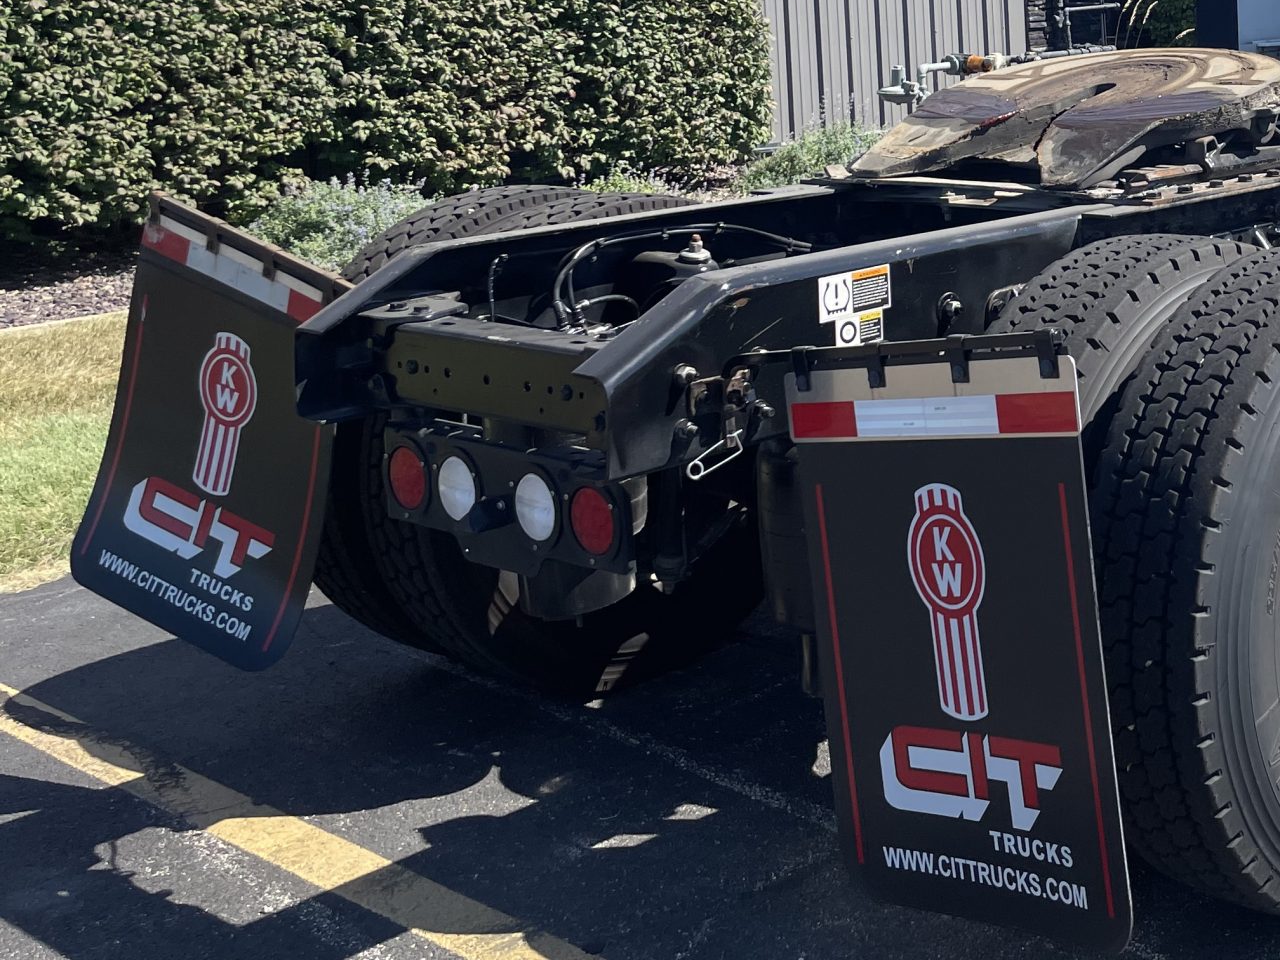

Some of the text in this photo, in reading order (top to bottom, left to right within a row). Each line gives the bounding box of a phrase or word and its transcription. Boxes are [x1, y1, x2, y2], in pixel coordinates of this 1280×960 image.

[123, 476, 276, 579] CIT
[99, 548, 252, 642] WWW.CITTRUCKS.COM
[189, 567, 255, 612] TRUCKS
[879, 724, 1063, 831] CIT
[882, 845, 1089, 911] WWW.CITTRUCKS.COM
[989, 830, 1074, 868] TRUCKS
